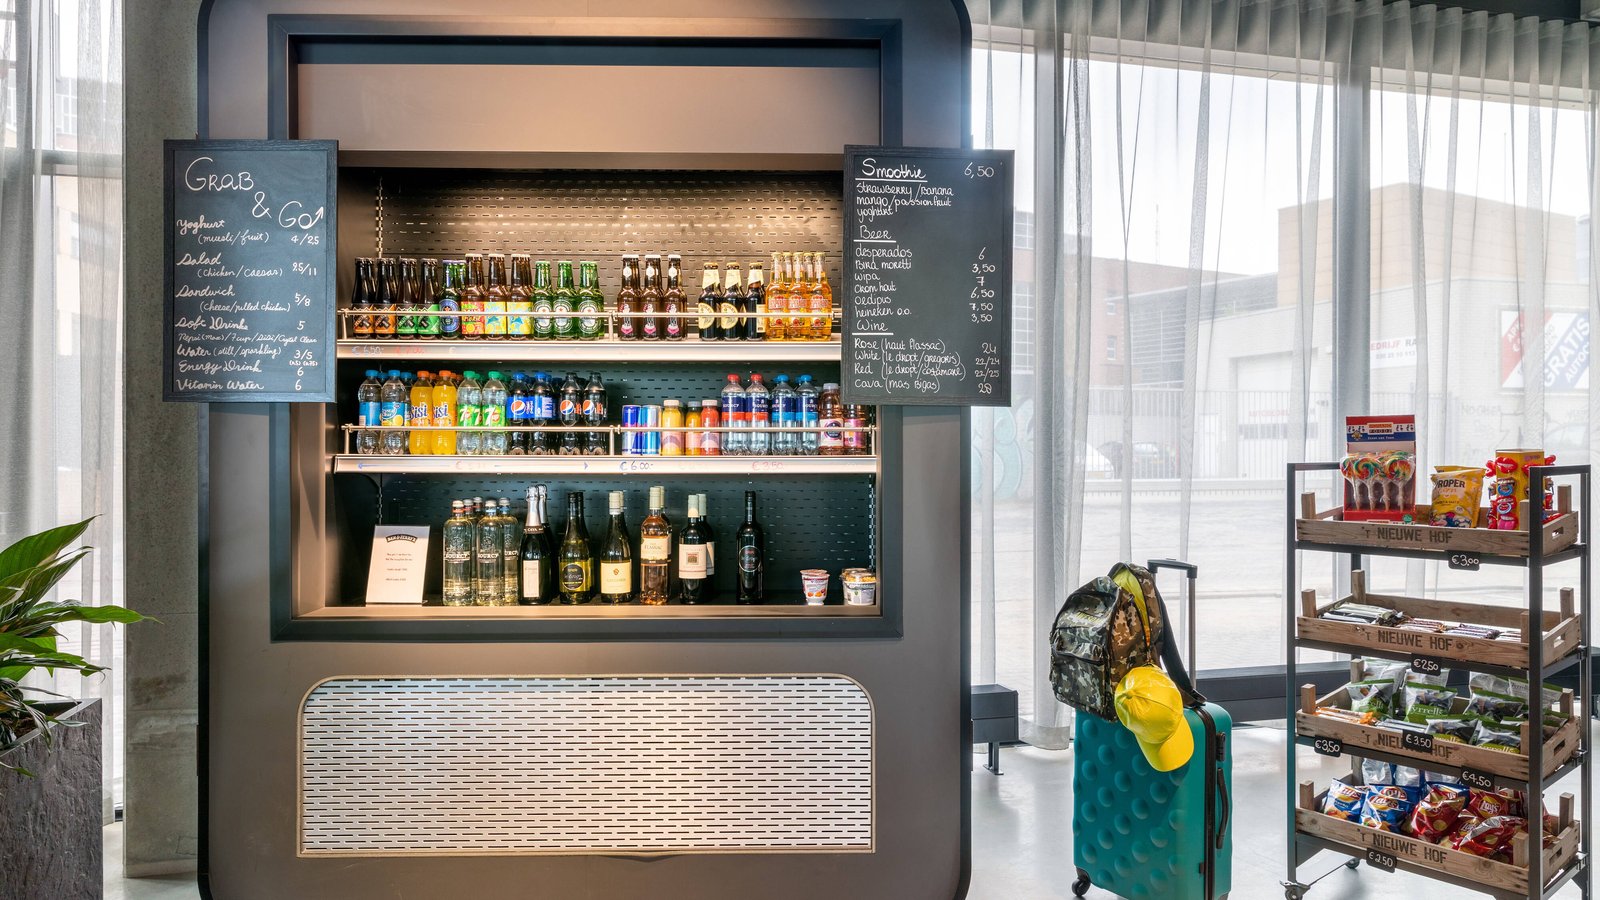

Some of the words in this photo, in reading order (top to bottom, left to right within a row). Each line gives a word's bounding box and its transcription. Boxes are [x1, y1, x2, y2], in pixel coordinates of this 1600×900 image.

[862, 158, 926, 179] Smoothie
[252, 191, 272, 218] &
[860, 225, 892, 240] Beer
[176, 252, 222, 266] Salad
[978, 247, 986, 260] 6
[976, 276, 985, 286] 7
[175, 284, 236, 297] Sandwich
[175, 315, 206, 331] Soft
[296, 320, 306, 330] 5
[856, 320, 888, 332] Wine
[176, 344, 212, 356] Water
[854, 338, 880, 349] Rose
[982, 342, 996, 354] 24
[178, 360, 222, 375] Energy
[223, 360, 262, 372] Drink
[296, 366, 304, 376] 6
[854, 363, 874, 374] Red
[176, 380, 223, 391] Vitamin
[226, 380, 264, 390] Water
[295, 379, 302, 390] 6
[1377, 527, 1422, 542] NIEUWE
[1429, 530, 1453, 544] HOF
[1378, 630, 1422, 648] NIEUWE
[1430, 636, 1454, 652] HOF
[1372, 834, 1418, 856] NIEUWE
[1424, 846, 1448, 864] HOF
